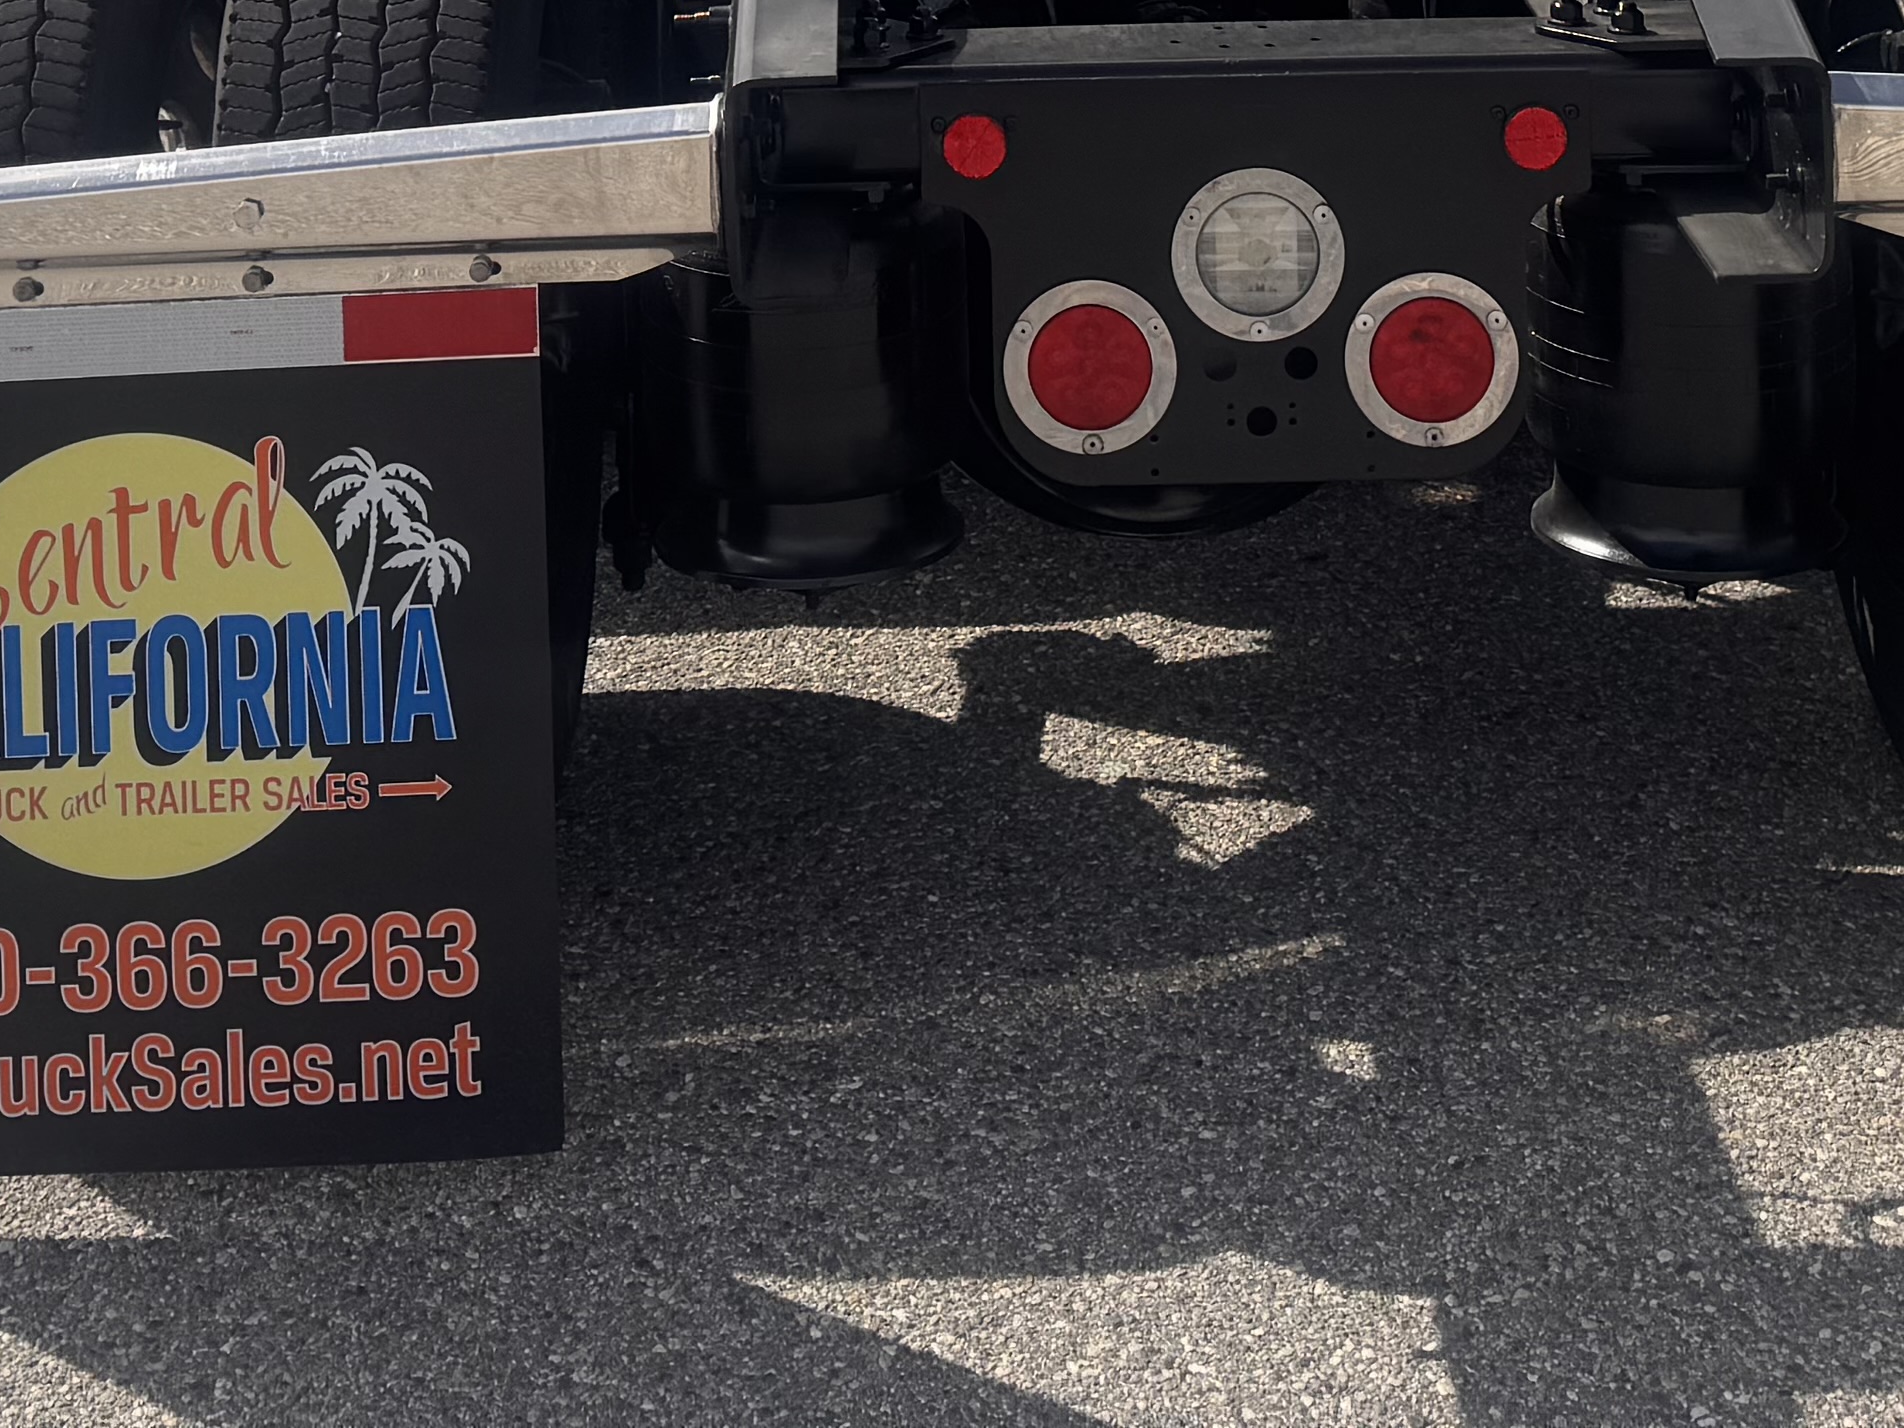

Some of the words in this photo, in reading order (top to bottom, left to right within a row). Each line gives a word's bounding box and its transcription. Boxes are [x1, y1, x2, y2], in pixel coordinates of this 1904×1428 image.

[61, 776, 107, 822] and
[114, 777, 251, 817] TRAILER
[262, 772, 371, 813] SALES
